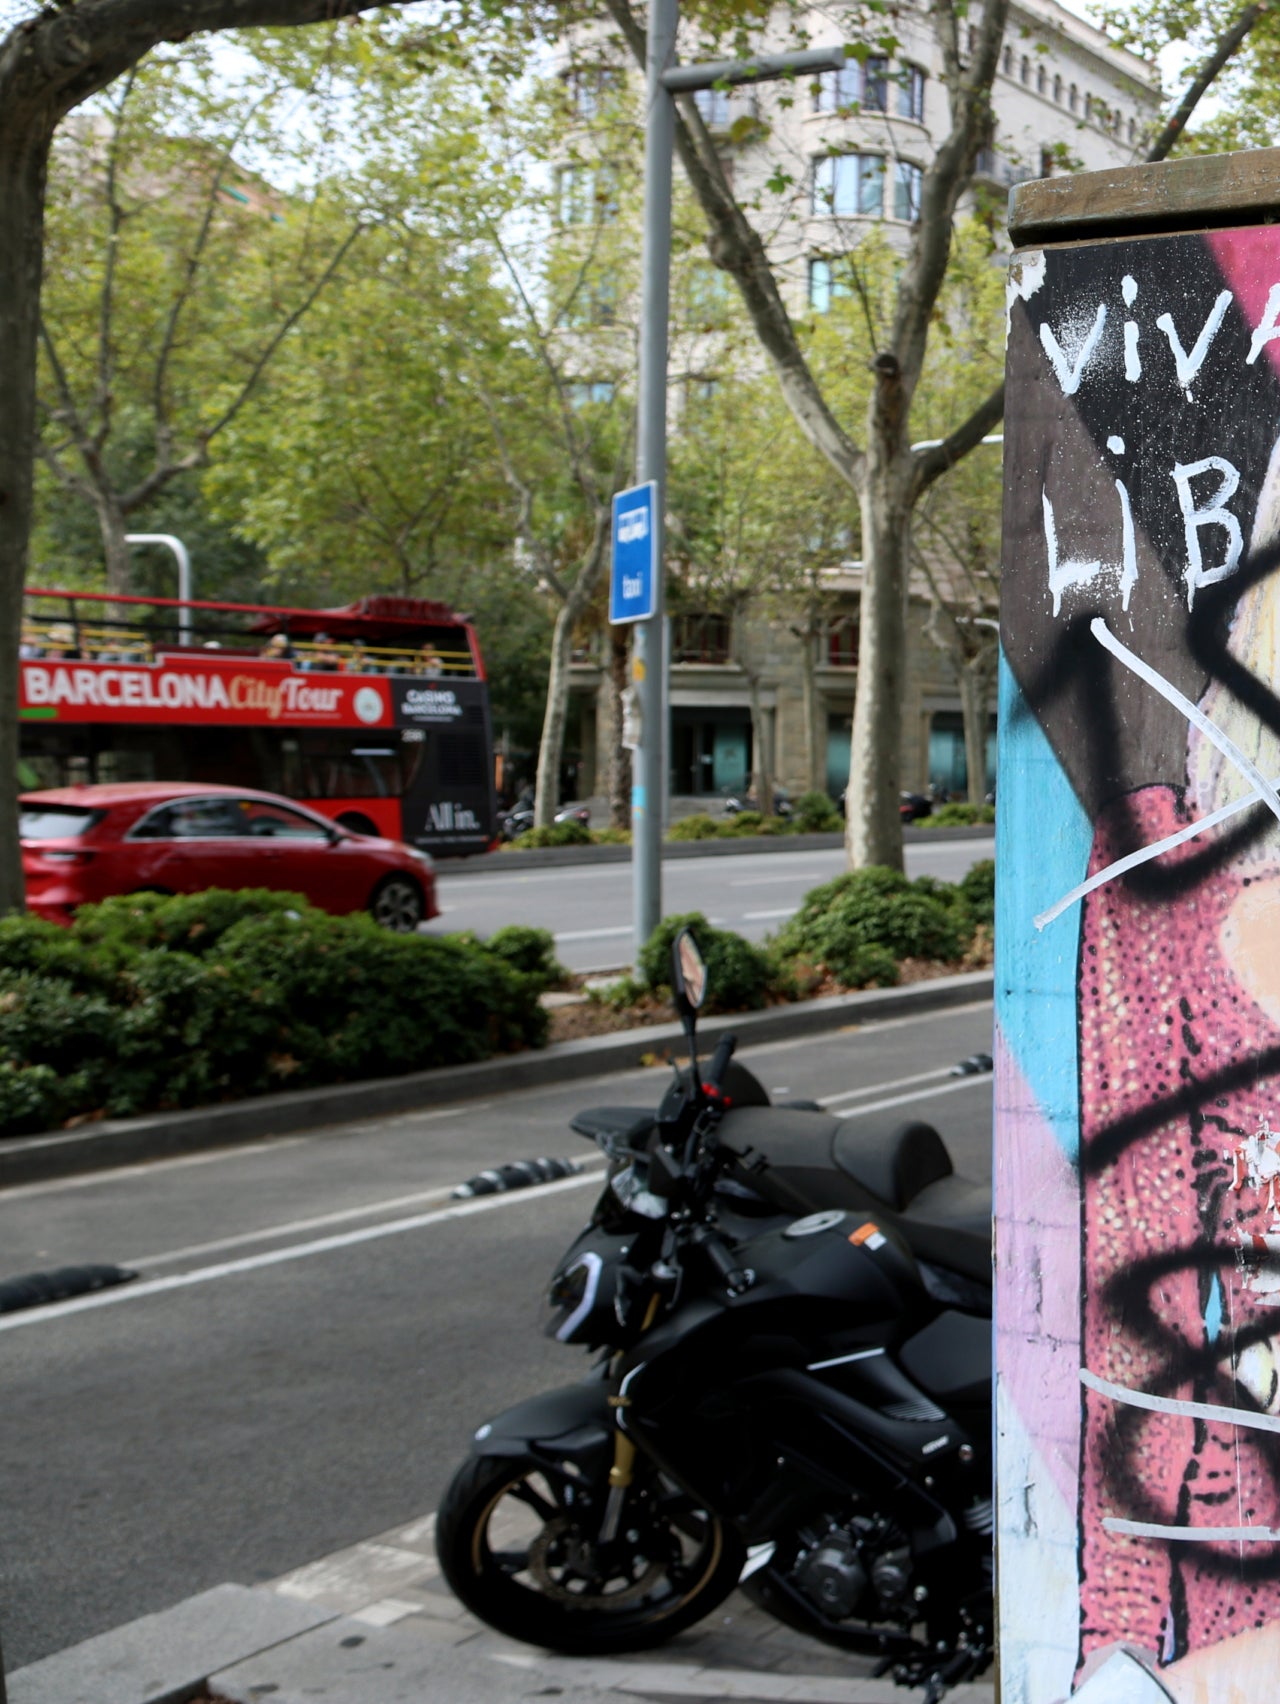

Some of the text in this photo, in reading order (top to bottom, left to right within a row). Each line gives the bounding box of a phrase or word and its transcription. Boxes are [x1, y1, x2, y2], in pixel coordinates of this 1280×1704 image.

[622, 571, 643, 599] taxi
[23, 666, 344, 720] BARCELONA City Tour
